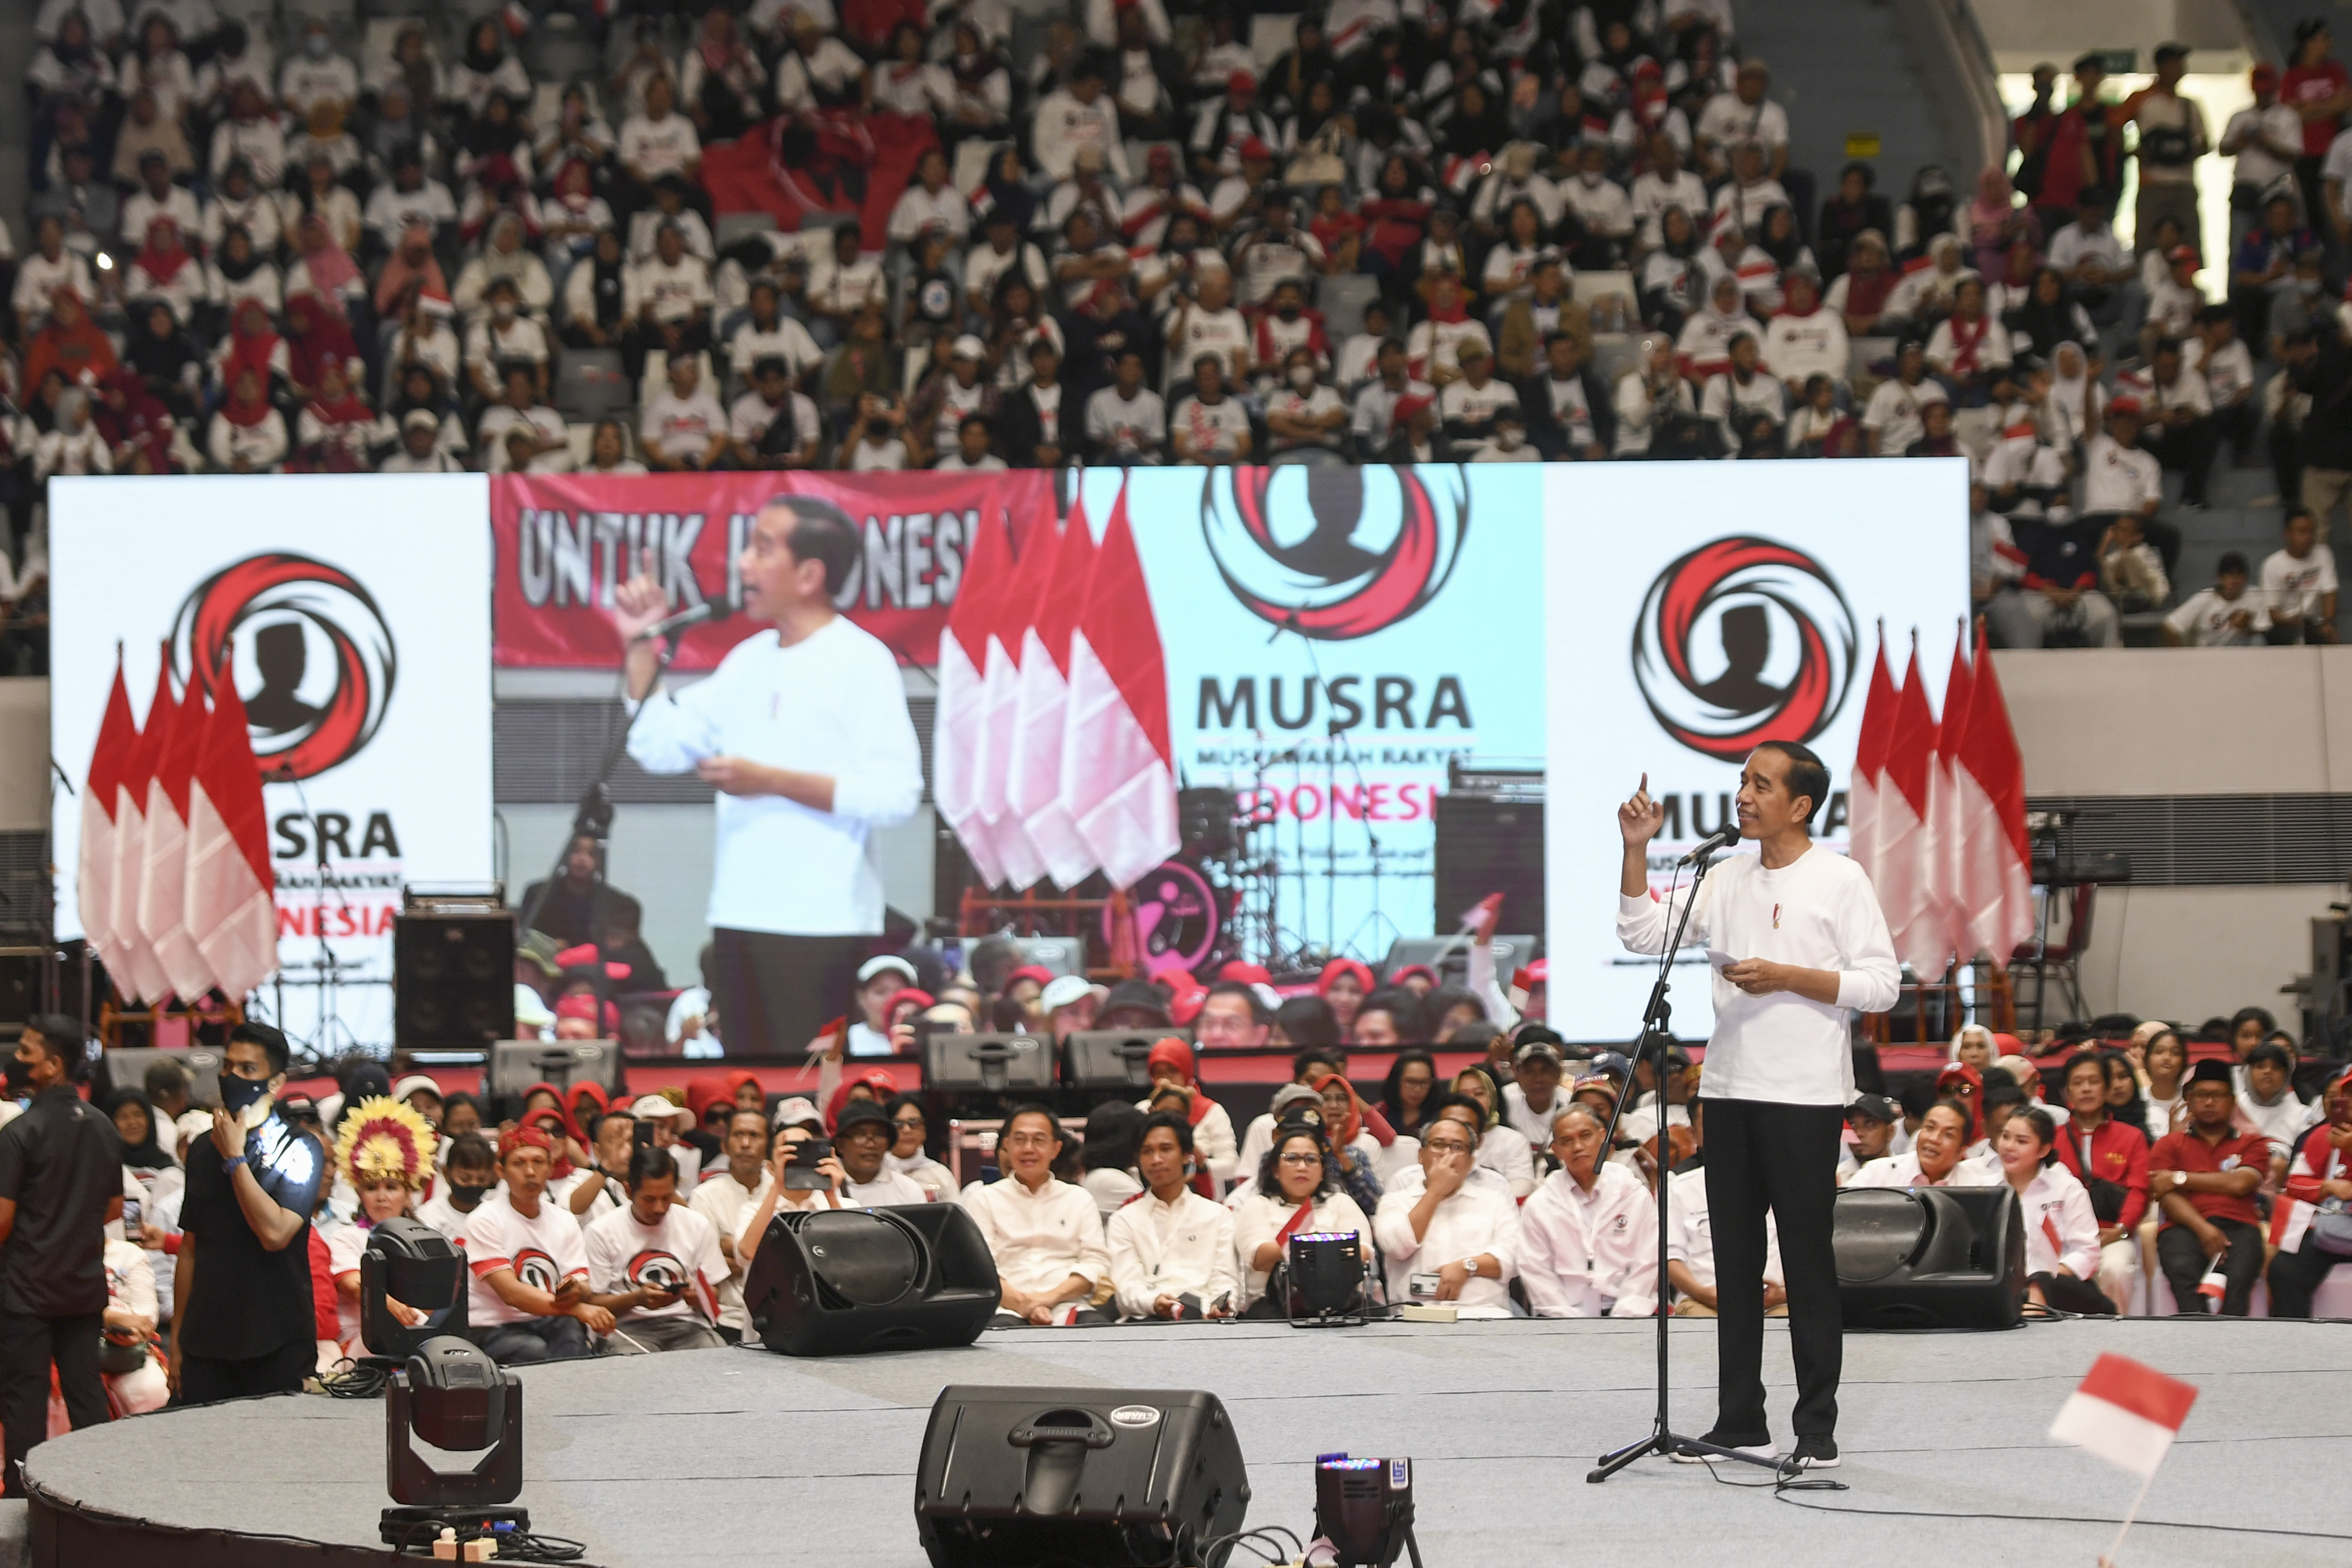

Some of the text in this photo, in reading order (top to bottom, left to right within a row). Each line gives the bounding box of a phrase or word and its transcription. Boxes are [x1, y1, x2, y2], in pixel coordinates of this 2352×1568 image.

[520, 509, 980, 609] UNTUK INES
[1198, 675, 1474, 730] MUSRA
[1236, 782, 1437, 821] DONESI
[1651, 792, 1850, 839] MUA
[275, 813, 401, 859] SRA
